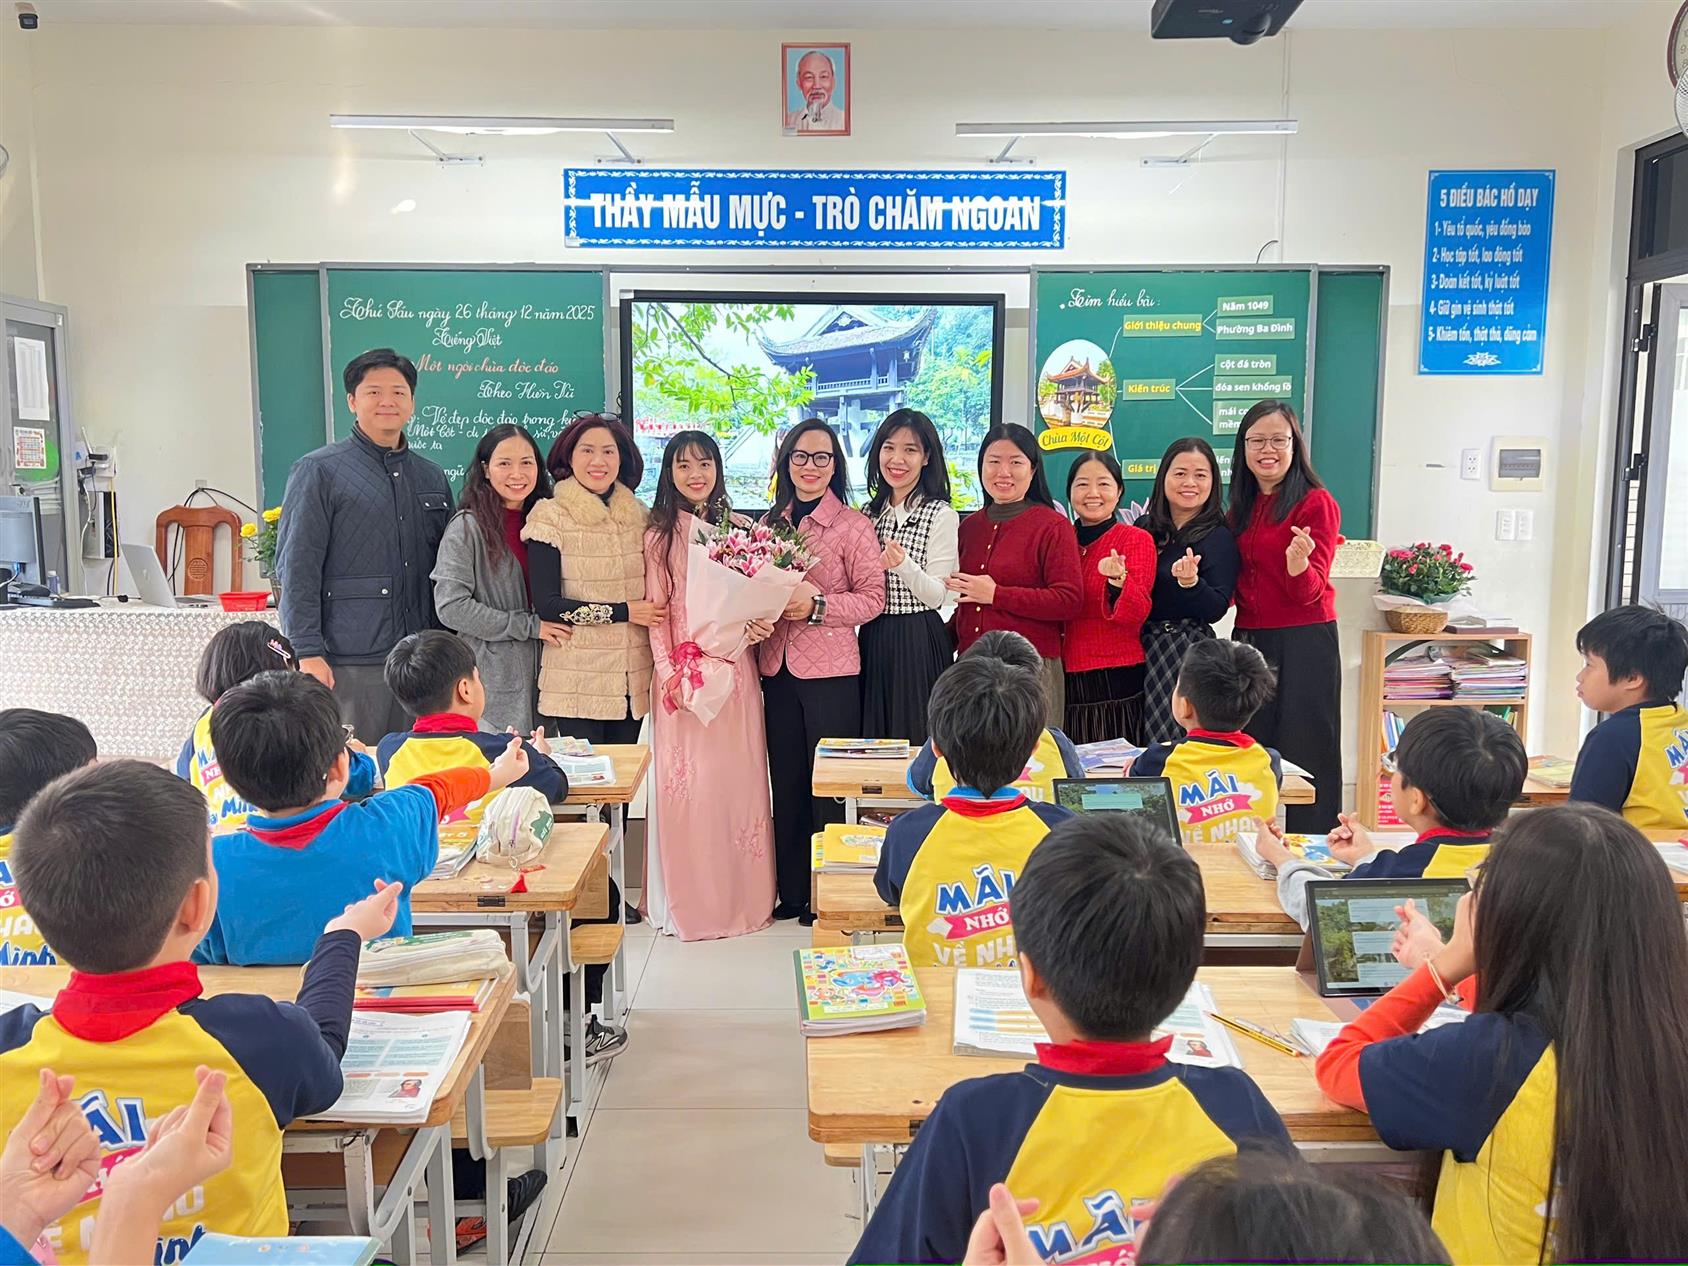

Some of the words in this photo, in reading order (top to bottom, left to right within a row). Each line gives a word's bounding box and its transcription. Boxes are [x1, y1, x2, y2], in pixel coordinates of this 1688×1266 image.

[1440, 188, 1448, 208] 5
[1476, 184, 1499, 208] BÁC
[1517, 188, 1540, 211] DẠY
[590, 181, 655, 228] THẦY
[662, 180, 720, 229] MẪU
[728, 190, 787, 237] MỰC
[794, 210, 805, 219] -
[812, 187, 868, 230] TRÒ
[870, 189, 940, 231] CHĂM
[951, 195, 1041, 231] NGOAN
[1434, 220, 1442, 237] 1-
[1432, 246, 1440, 263] 2-
[1431, 273, 1438, 289] 3-
[417, 306, 452, 328] ngày
[455, 303, 473, 319] 26
[475, 300, 518, 328] tháng
[520, 304, 534, 320] 12
[533, 308, 566, 320] năm
[565, 304, 597, 320] 2025
[1222, 302, 1246, 311] Năm
[1247, 301, 1269, 310] 1049
[1172, 320, 1202, 331] chung
[1256, 324, 1269, 333] Ba
[431, 327, 476, 352] Tiếng
[475, 327, 504, 349] Việt
[473, 356, 506, 373] chùa
[534, 357, 560, 374] đáo
[1237, 360, 1249, 368] đá
[1250, 360, 1271, 369] tròn
[1150, 383, 1171, 393] trúc
[1215, 383, 1232, 392] đóa
[521, 412, 556, 431] trong
[1042, 432, 1068, 447] Chùa
[1127, 463, 1144, 473] Giá
[1145, 463, 1158, 474] trị
[1179, 769, 1240, 806] MÃI
[936, 864, 1016, 914] MÃI
[963, 906, 1011, 931] NHỚ
